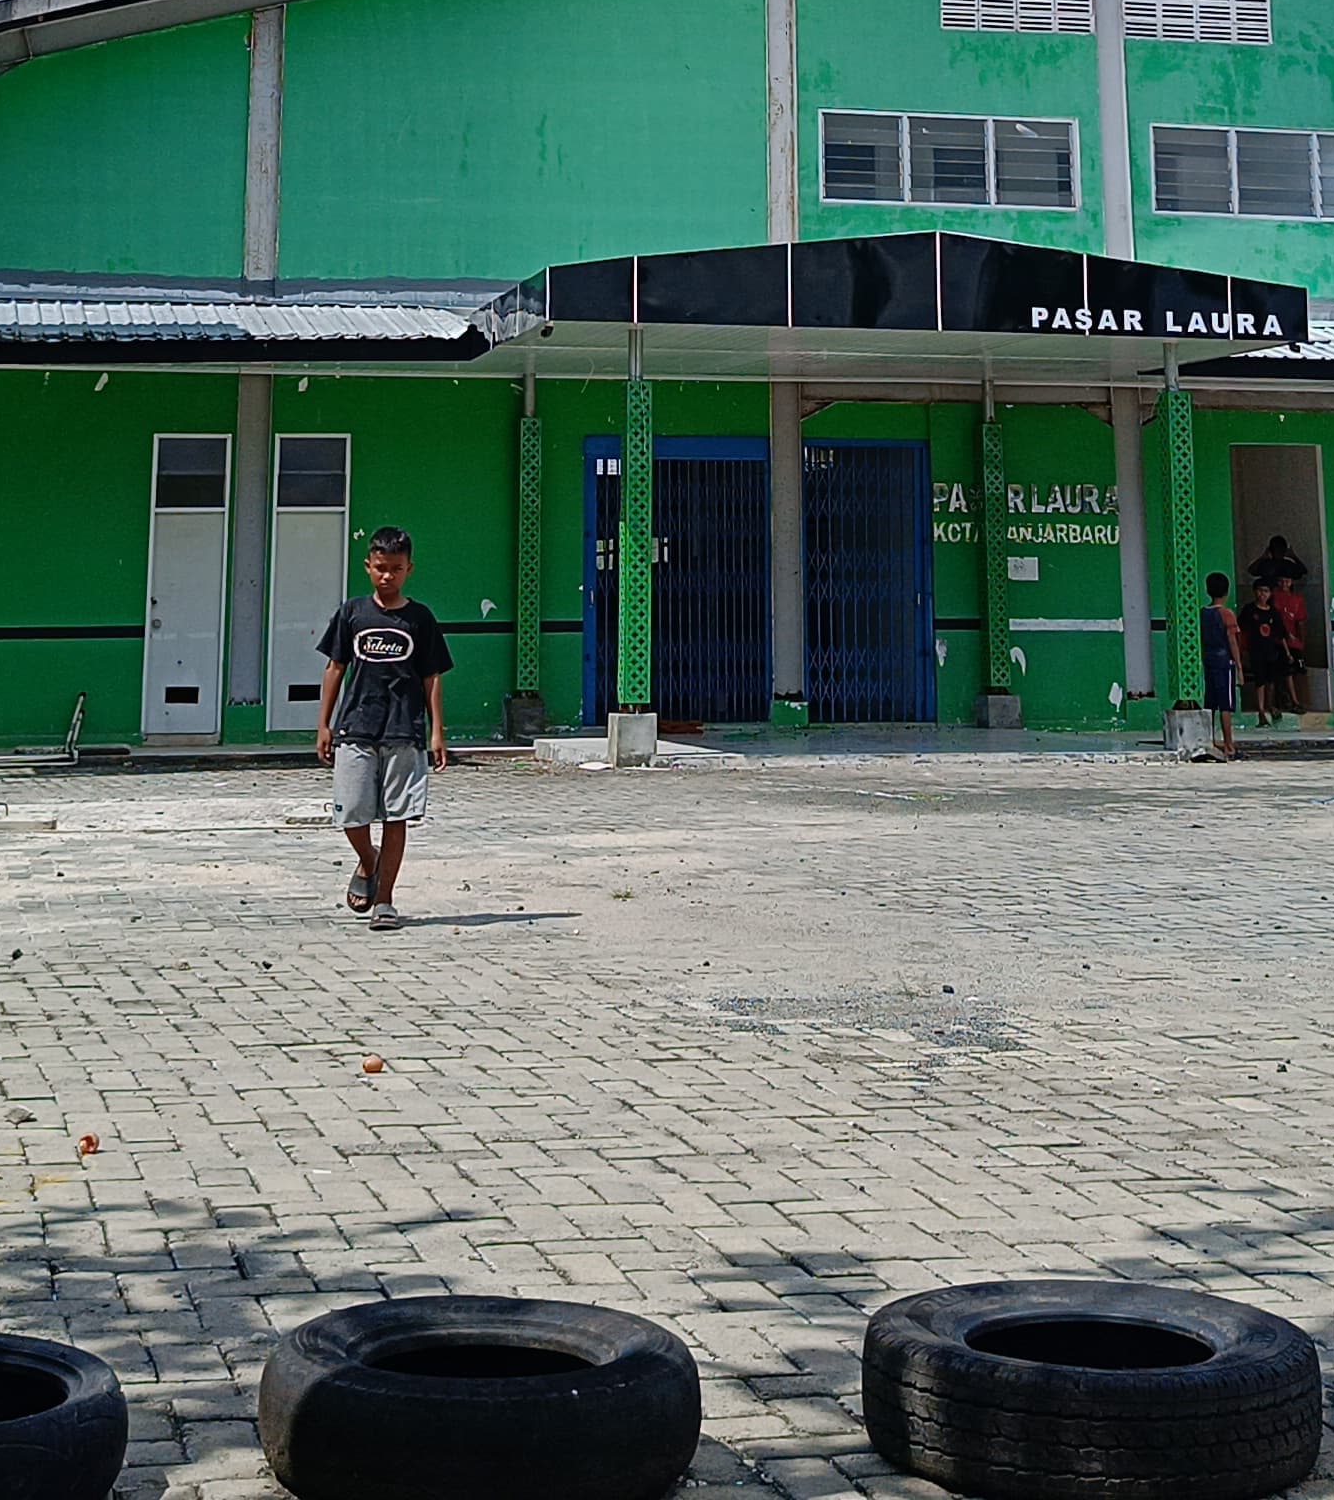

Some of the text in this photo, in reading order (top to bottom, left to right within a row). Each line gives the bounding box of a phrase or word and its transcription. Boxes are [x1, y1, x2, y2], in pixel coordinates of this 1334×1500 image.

[1031, 307, 1284, 336] PASAR LAURA
[1031, 483, 1120, 515] LAURA
